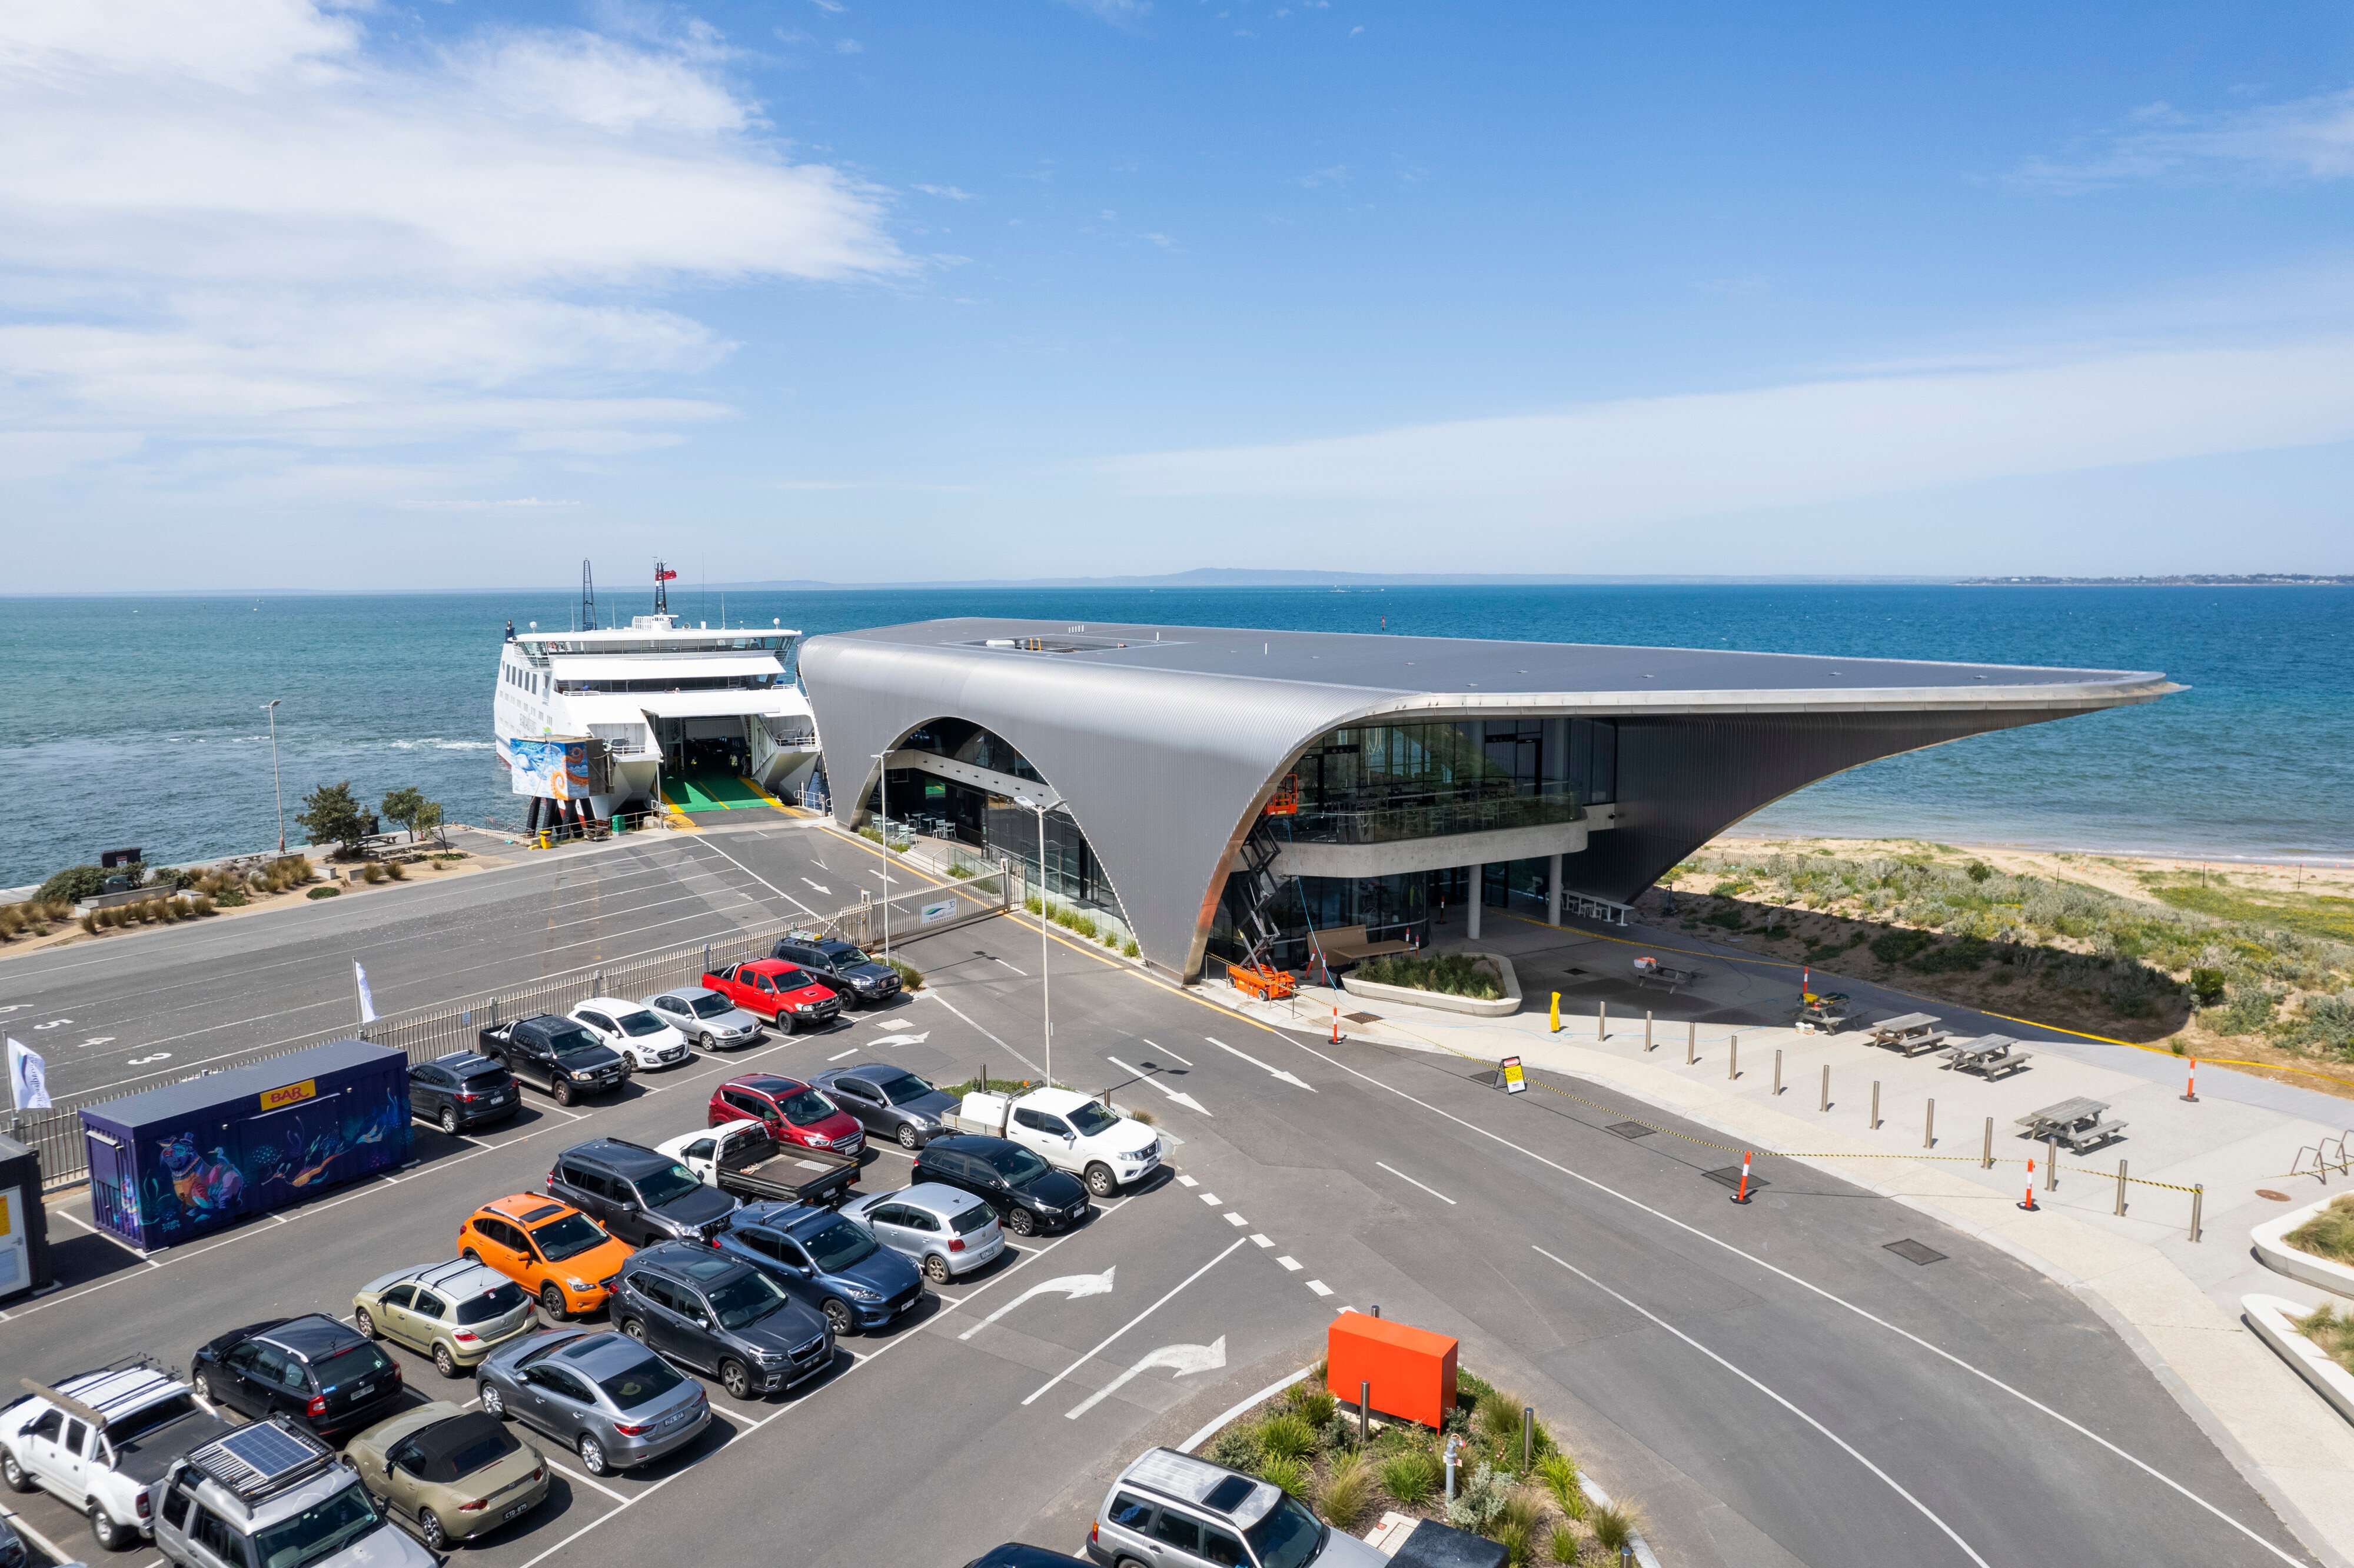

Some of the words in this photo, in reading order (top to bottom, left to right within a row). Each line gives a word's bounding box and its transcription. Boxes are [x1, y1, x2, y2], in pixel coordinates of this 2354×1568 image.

[34, 1018, 74, 1030] 5
[78, 1037, 116, 1047] 4
[128, 1053, 172, 1065] 3
[270, 1087, 310, 1103] BAR
